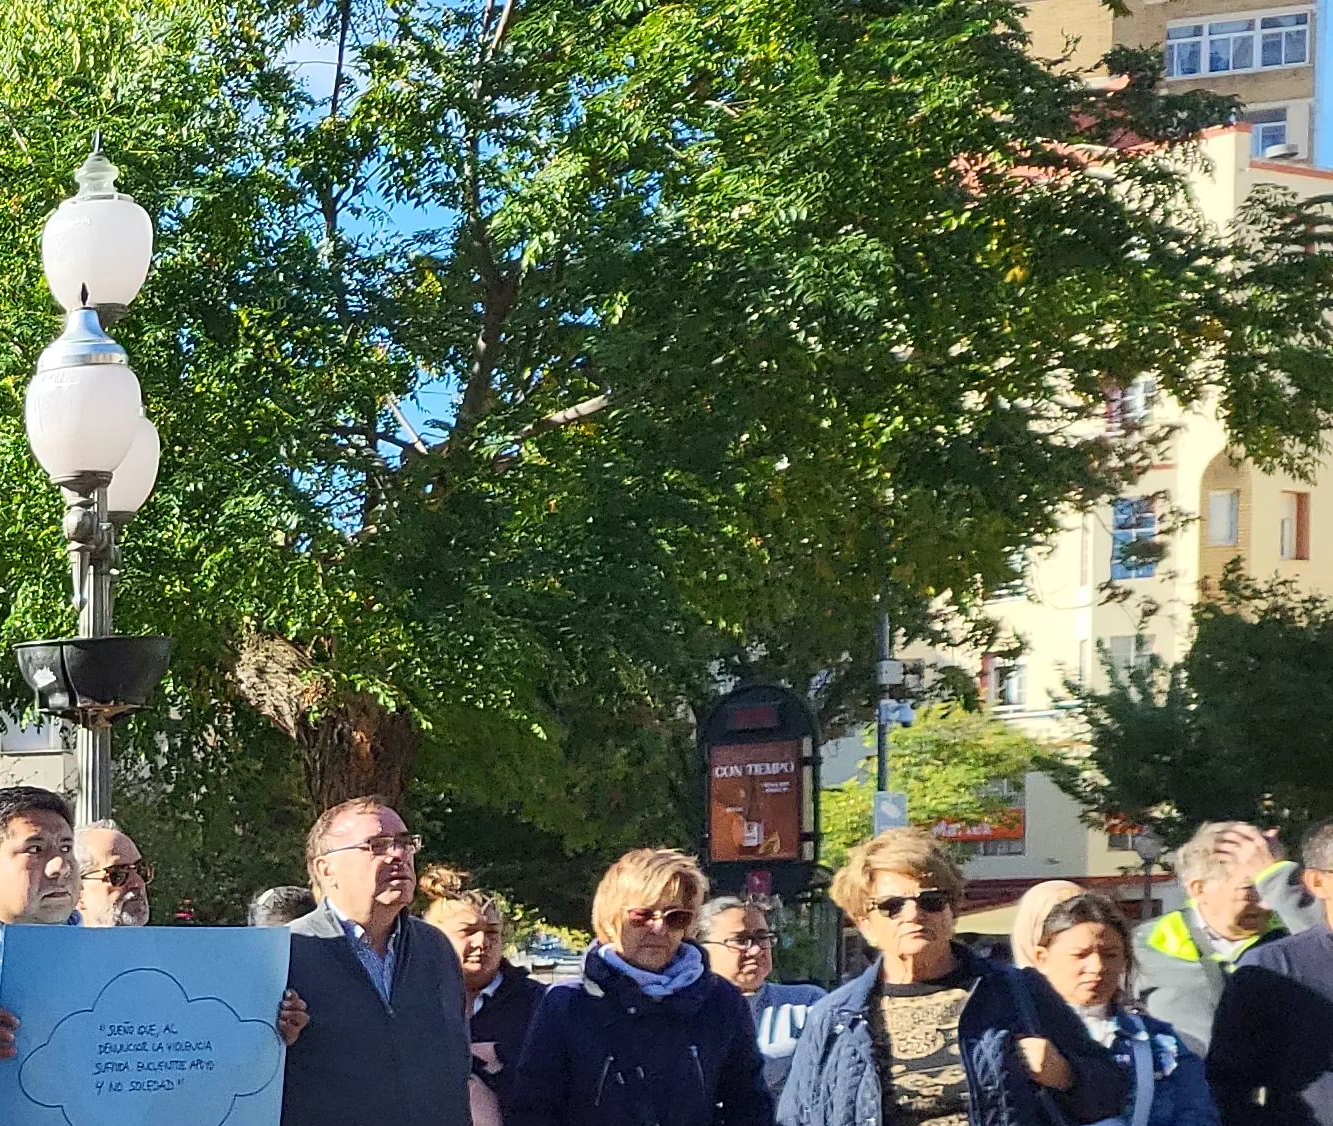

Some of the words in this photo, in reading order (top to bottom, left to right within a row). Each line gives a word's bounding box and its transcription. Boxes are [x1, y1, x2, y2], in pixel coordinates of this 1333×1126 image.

[714, 764, 743, 778] CON
[746, 761, 795, 776] TIEMPO
[152, 1043, 164, 1052] LA
[96, 1080, 104, 1096] Y
[109, 1081, 123, 1092] NO
